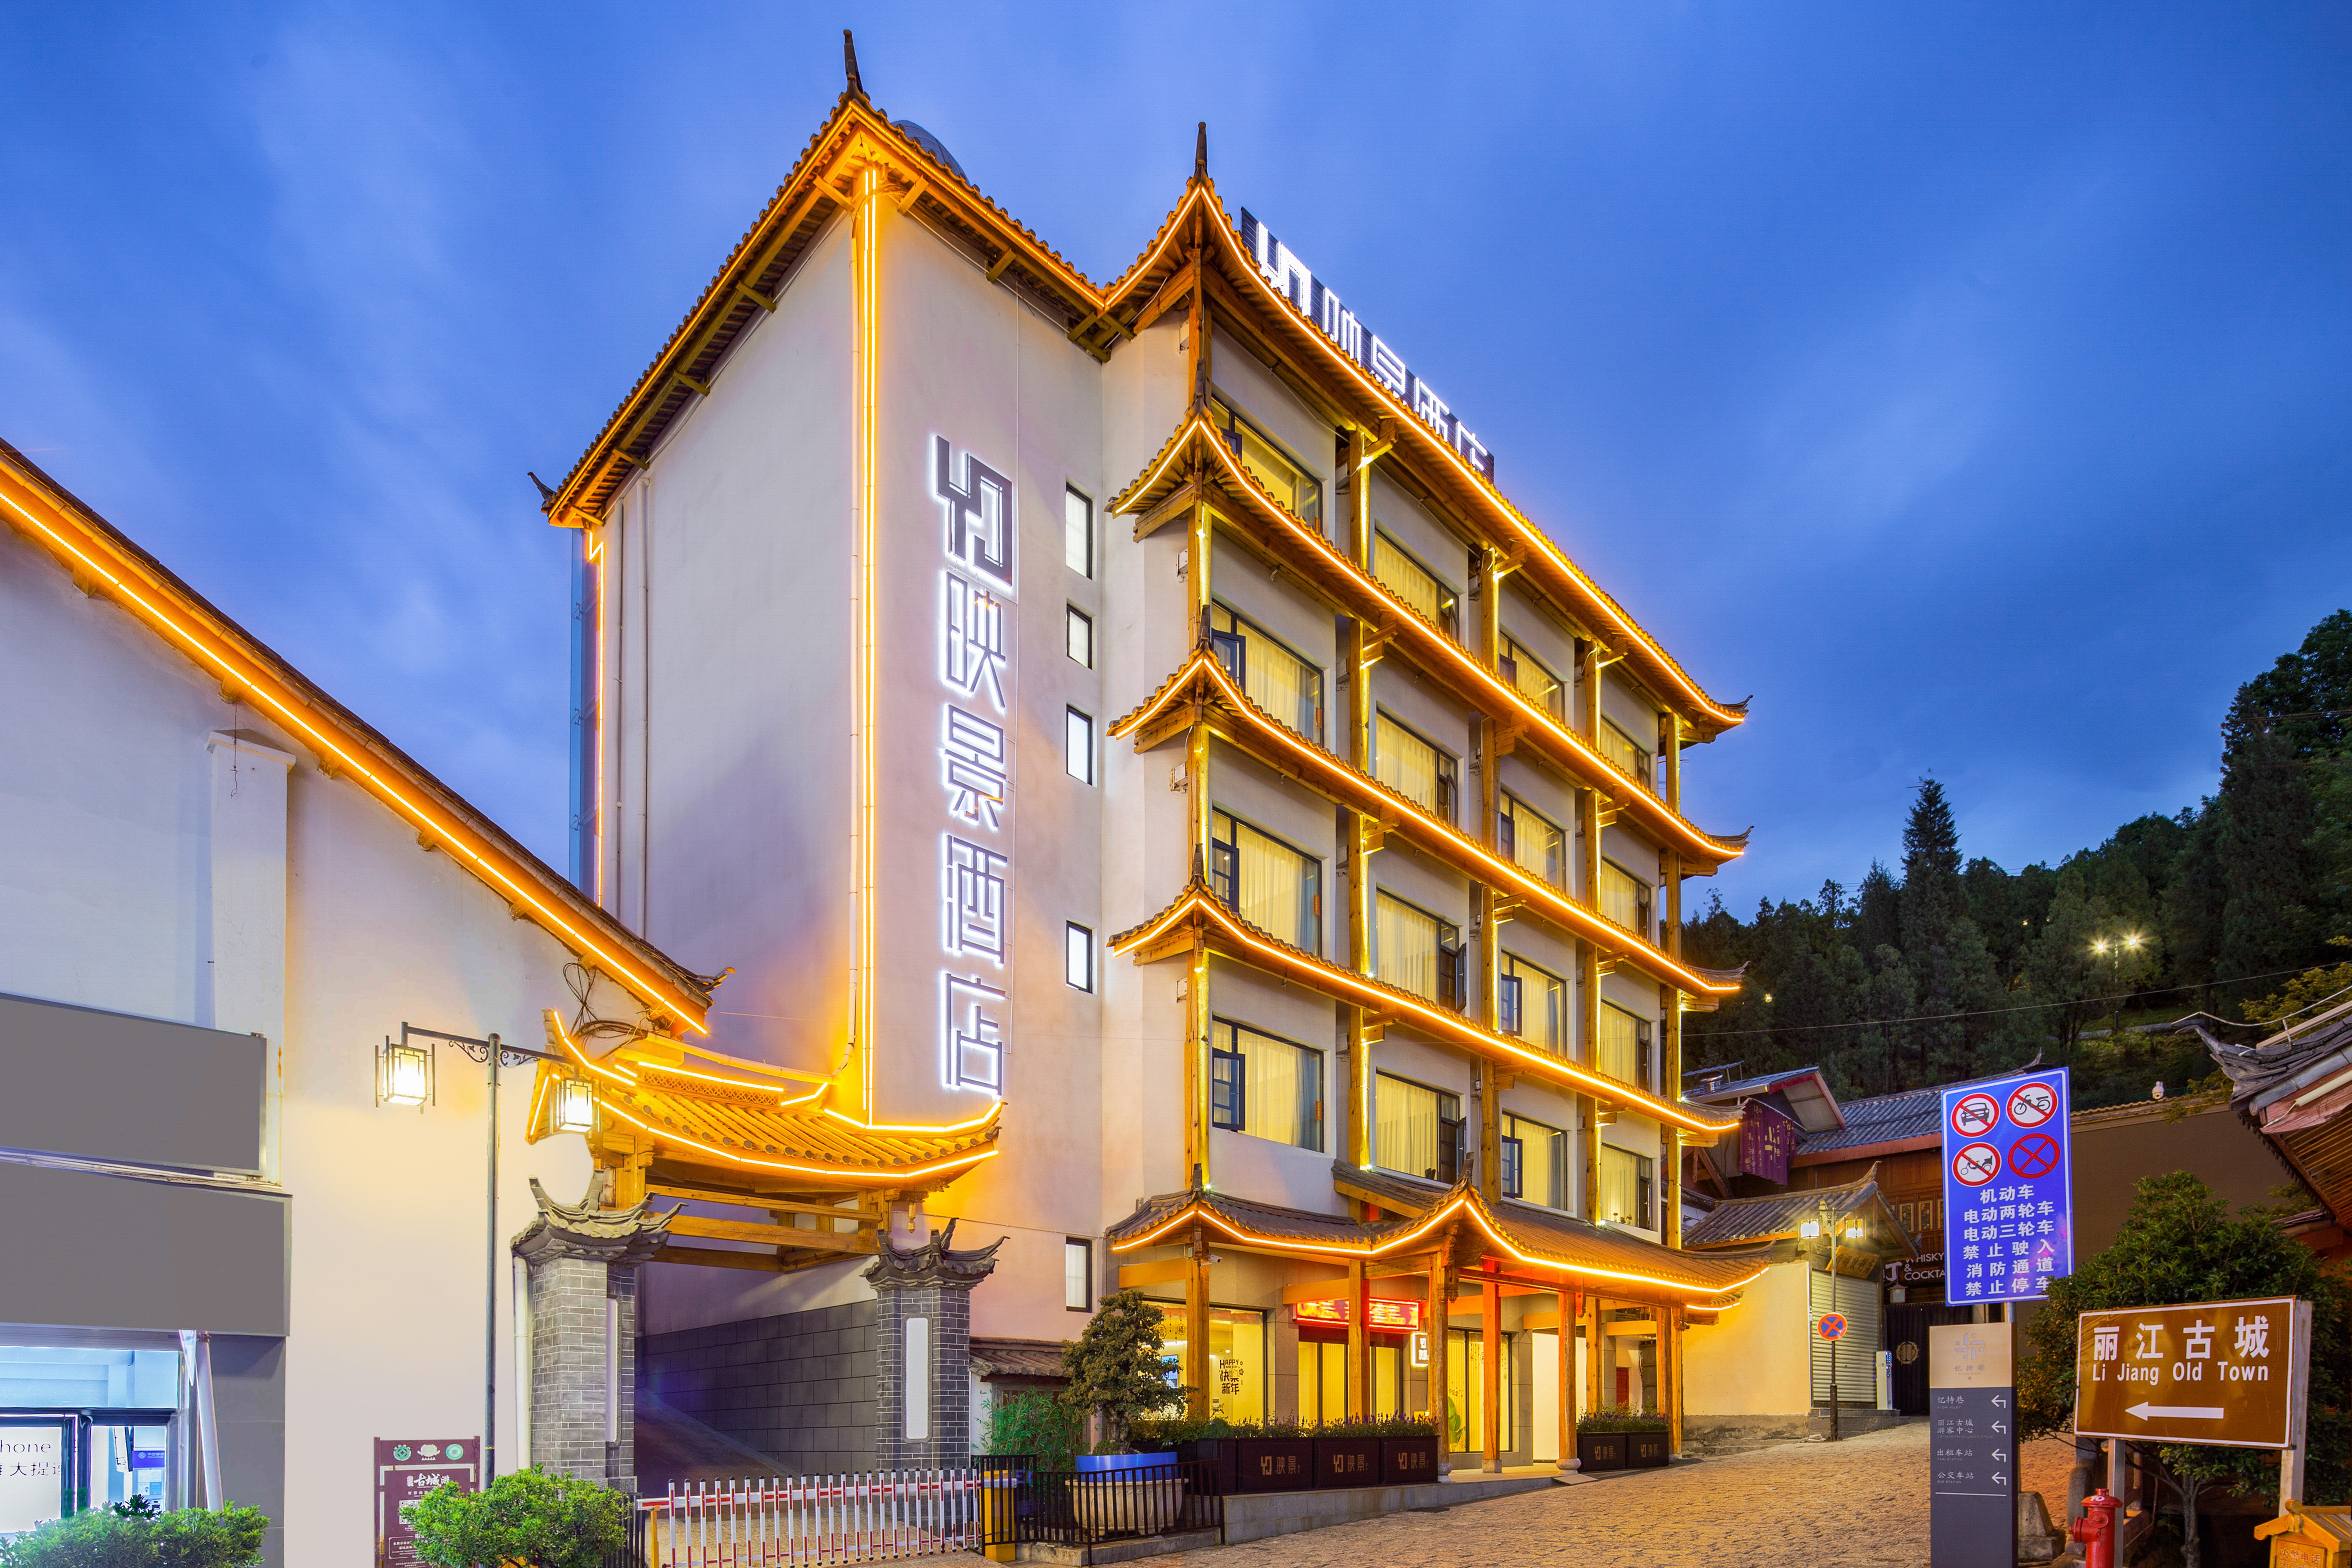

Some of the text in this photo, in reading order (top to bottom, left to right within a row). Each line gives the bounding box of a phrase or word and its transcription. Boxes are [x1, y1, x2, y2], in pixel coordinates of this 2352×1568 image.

[946, 571, 1006, 1096] 映景酒店
[1980, 1184, 2034, 1204] 机动车
[1964, 1201, 2055, 1224] 电动两轮车
[1963, 1220, 2055, 1242] 电动三轮车
[1963, 1238, 2054, 1260] 禁止驶入
[1966, 1257, 2054, 1279] 消防通道
[1966, 1275, 2051, 1297] 禁止停车
[2093, 1315, 2270, 1361] 丽江古城
[1220, 1359, 1239, 1369] HAPPY
[2093, 1361, 2269, 1386] Li Jiang Old Town
[1222, 1382, 1239, 1395] 新年
[1937, 1396, 1964, 1404] 忆持巷
[1277, 1456, 1296, 1474] 映景
[1348, 1454, 1364, 1472] 映景
[1411, 1452, 1426, 1469] 映景
[1937, 1471, 1974, 1479] 公交车站
[2280, 1548, 2321, 1565] 火警电话
